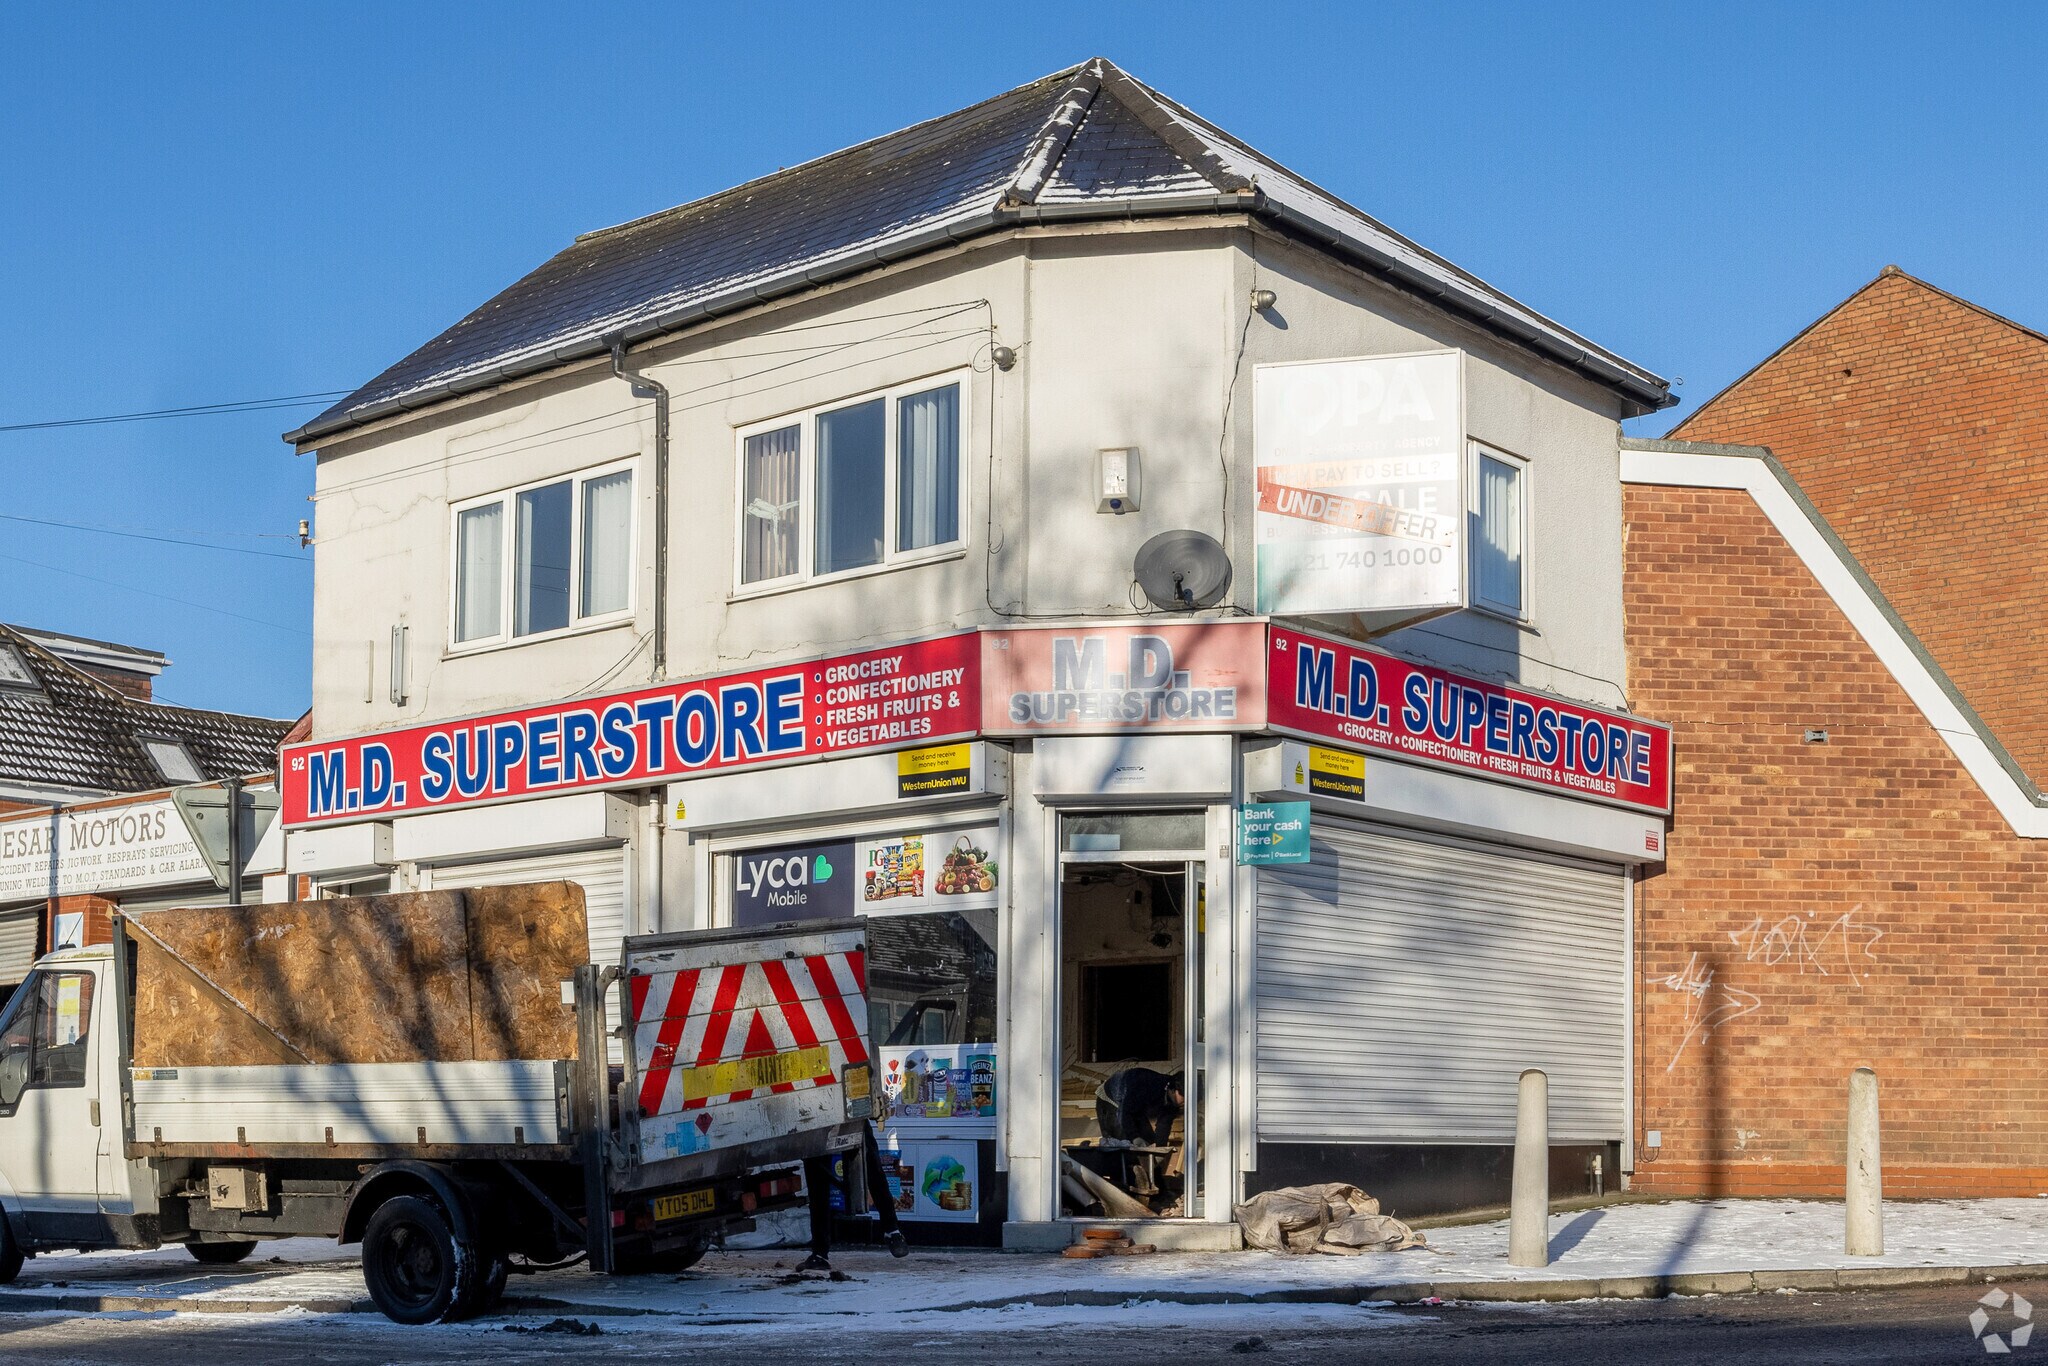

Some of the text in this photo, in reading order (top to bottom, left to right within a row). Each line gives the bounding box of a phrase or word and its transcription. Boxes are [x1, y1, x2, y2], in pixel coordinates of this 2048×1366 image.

[1395, 436, 1441, 450] AGENCY
[1315, 466, 1348, 482] PAY
[1352, 464, 1377, 479] TO
[1276, 488, 1438, 540] UNDER OFFER
[1335, 550, 1377, 569] 740
[1383, 546, 1443, 567] 1000
[991, 638, 1009, 650] 92
[1275, 637, 1287, 651] 92
[825, 656, 904, 684] GROCERY
[1053, 634, 1192, 690] M.D.
[826, 667, 965, 705] CONFECTIONERY
[1295, 642, 1391, 727] M.D.
[826, 690, 961, 727] FRESH FRUITS &
[1008, 686, 1238, 724] SUPERSTORE
[420, 672, 805, 803] SUPERSTORE
[826, 717, 932, 747] VEGETABLES
[1401, 671, 1652, 788] SUPERSTORE
[291, 756, 306, 772] 92
[911, 750, 957, 762] Send and receive
[918, 759, 950, 769] money here
[1319, 751, 1355, 765] Send and receive
[1325, 762, 1350, 771] money here
[1344, 722, 1616, 794] GROCERY CONFECTIONERY FRESH FRUITS & VEGETABLES
[306, 741, 407, 819] M.D.
[1244, 808, 1275, 820] Bank
[70, 810, 166, 851] MOTORS
[1244, 819, 1302, 835] your cash
[3, 826, 57, 859] ESAR
[1244, 835, 1271, 846] here
[34, 858, 65, 872] REPAIRS
[107, 849, 146, 863] RESPRAYS
[25, 875, 60, 890] WELDING
[63, 874, 73, 885] TO
[76, 870, 99, 883] M.O.T.
[100, 866, 147, 881] STANDARDS
[150, 864, 156, 875] &
[159, 861, 176, 874] CAR
[736, 854, 809, 898] Lyca
[767, 890, 808, 908] Mobile
[972, 1061, 993, 1071] HEINZ
[971, 1073, 993, 1084] BEANZ
[656, 1191, 714, 1217] YT05 DHL
